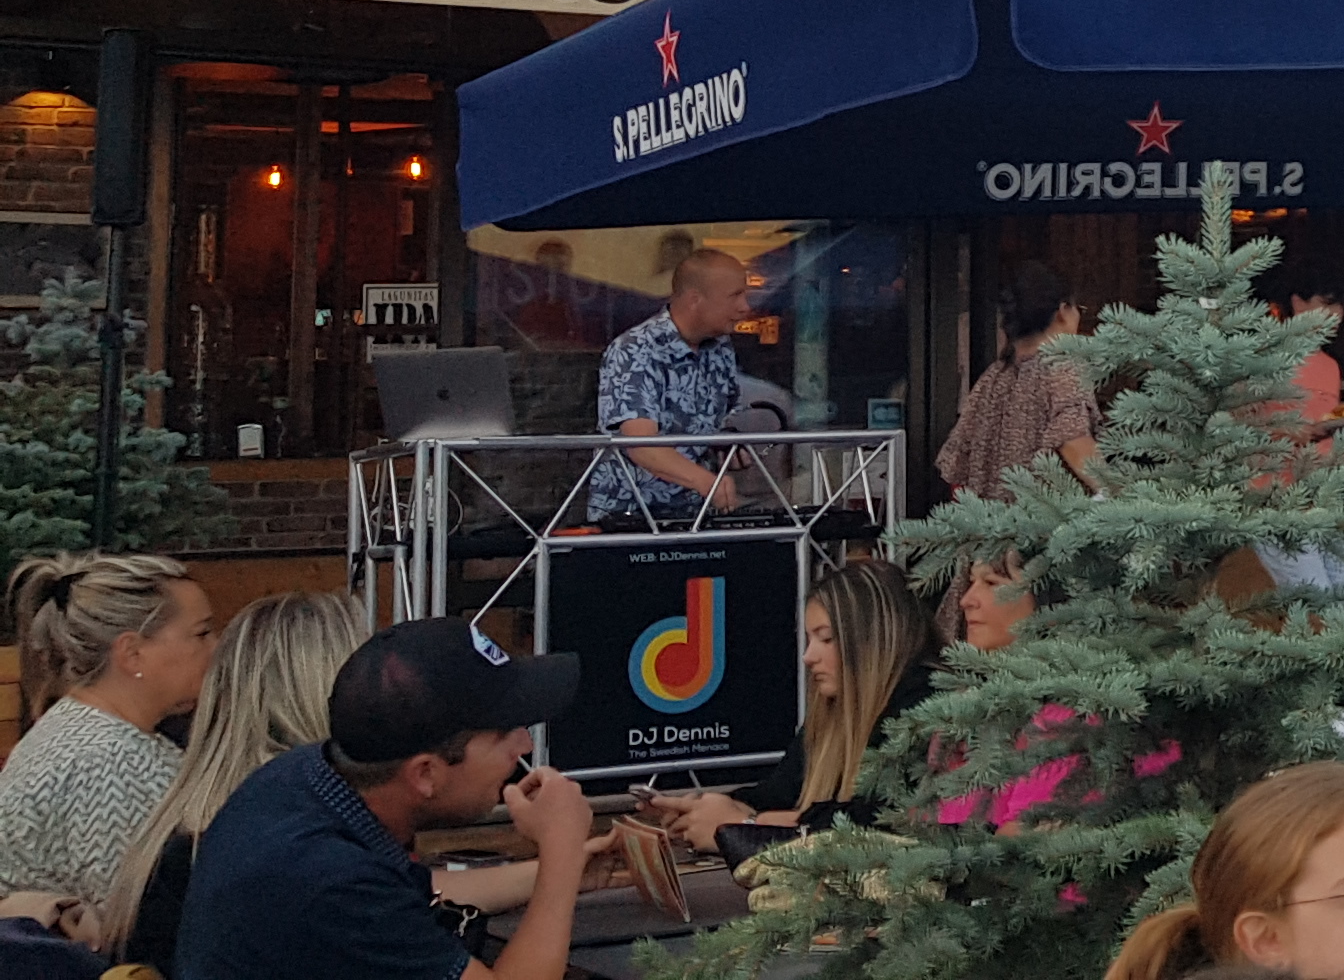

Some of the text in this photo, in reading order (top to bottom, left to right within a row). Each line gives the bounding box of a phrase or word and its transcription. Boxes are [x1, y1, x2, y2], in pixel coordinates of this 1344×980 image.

[628, 721, 730, 746] DJ Dennis
[628, 743, 730, 759] The Swedish Menace
